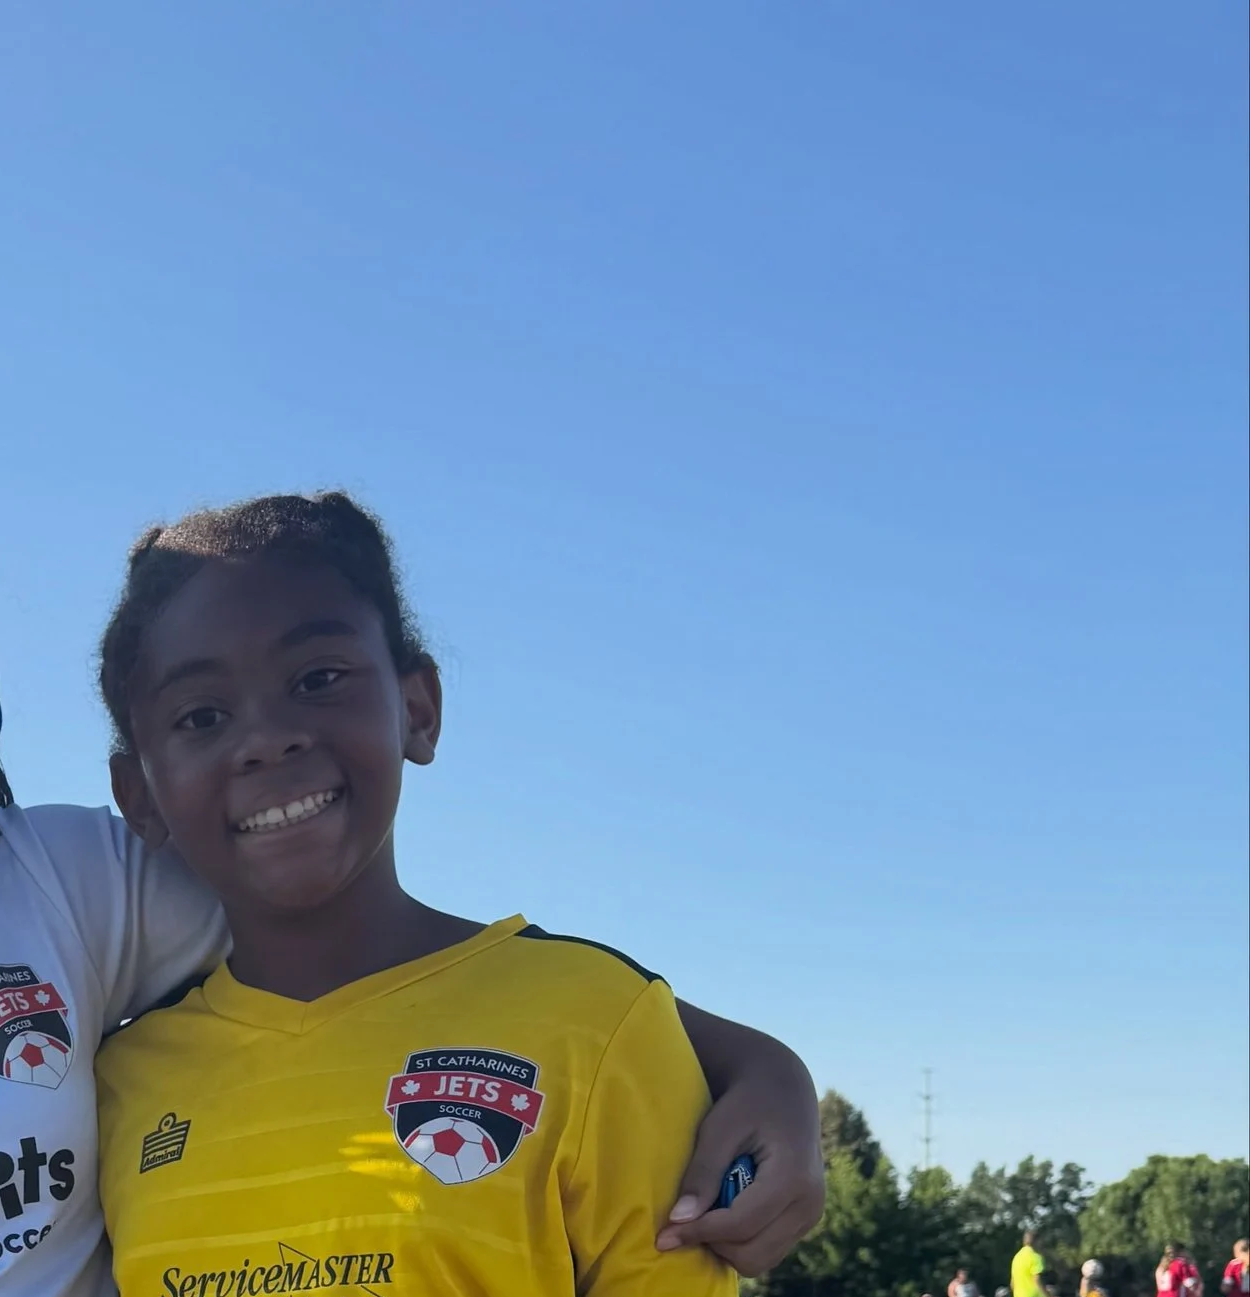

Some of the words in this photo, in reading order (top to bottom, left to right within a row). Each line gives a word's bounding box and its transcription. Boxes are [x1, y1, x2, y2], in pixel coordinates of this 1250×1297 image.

[4, 1020, 33, 1035] SOCCER
[416, 1058, 433, 1069] ST
[438, 1056, 530, 1079] CATHARINES
[434, 1076, 503, 1103] JETS
[439, 1105, 482, 1119] SOCCER
[143, 1146, 181, 1167] Admiral
